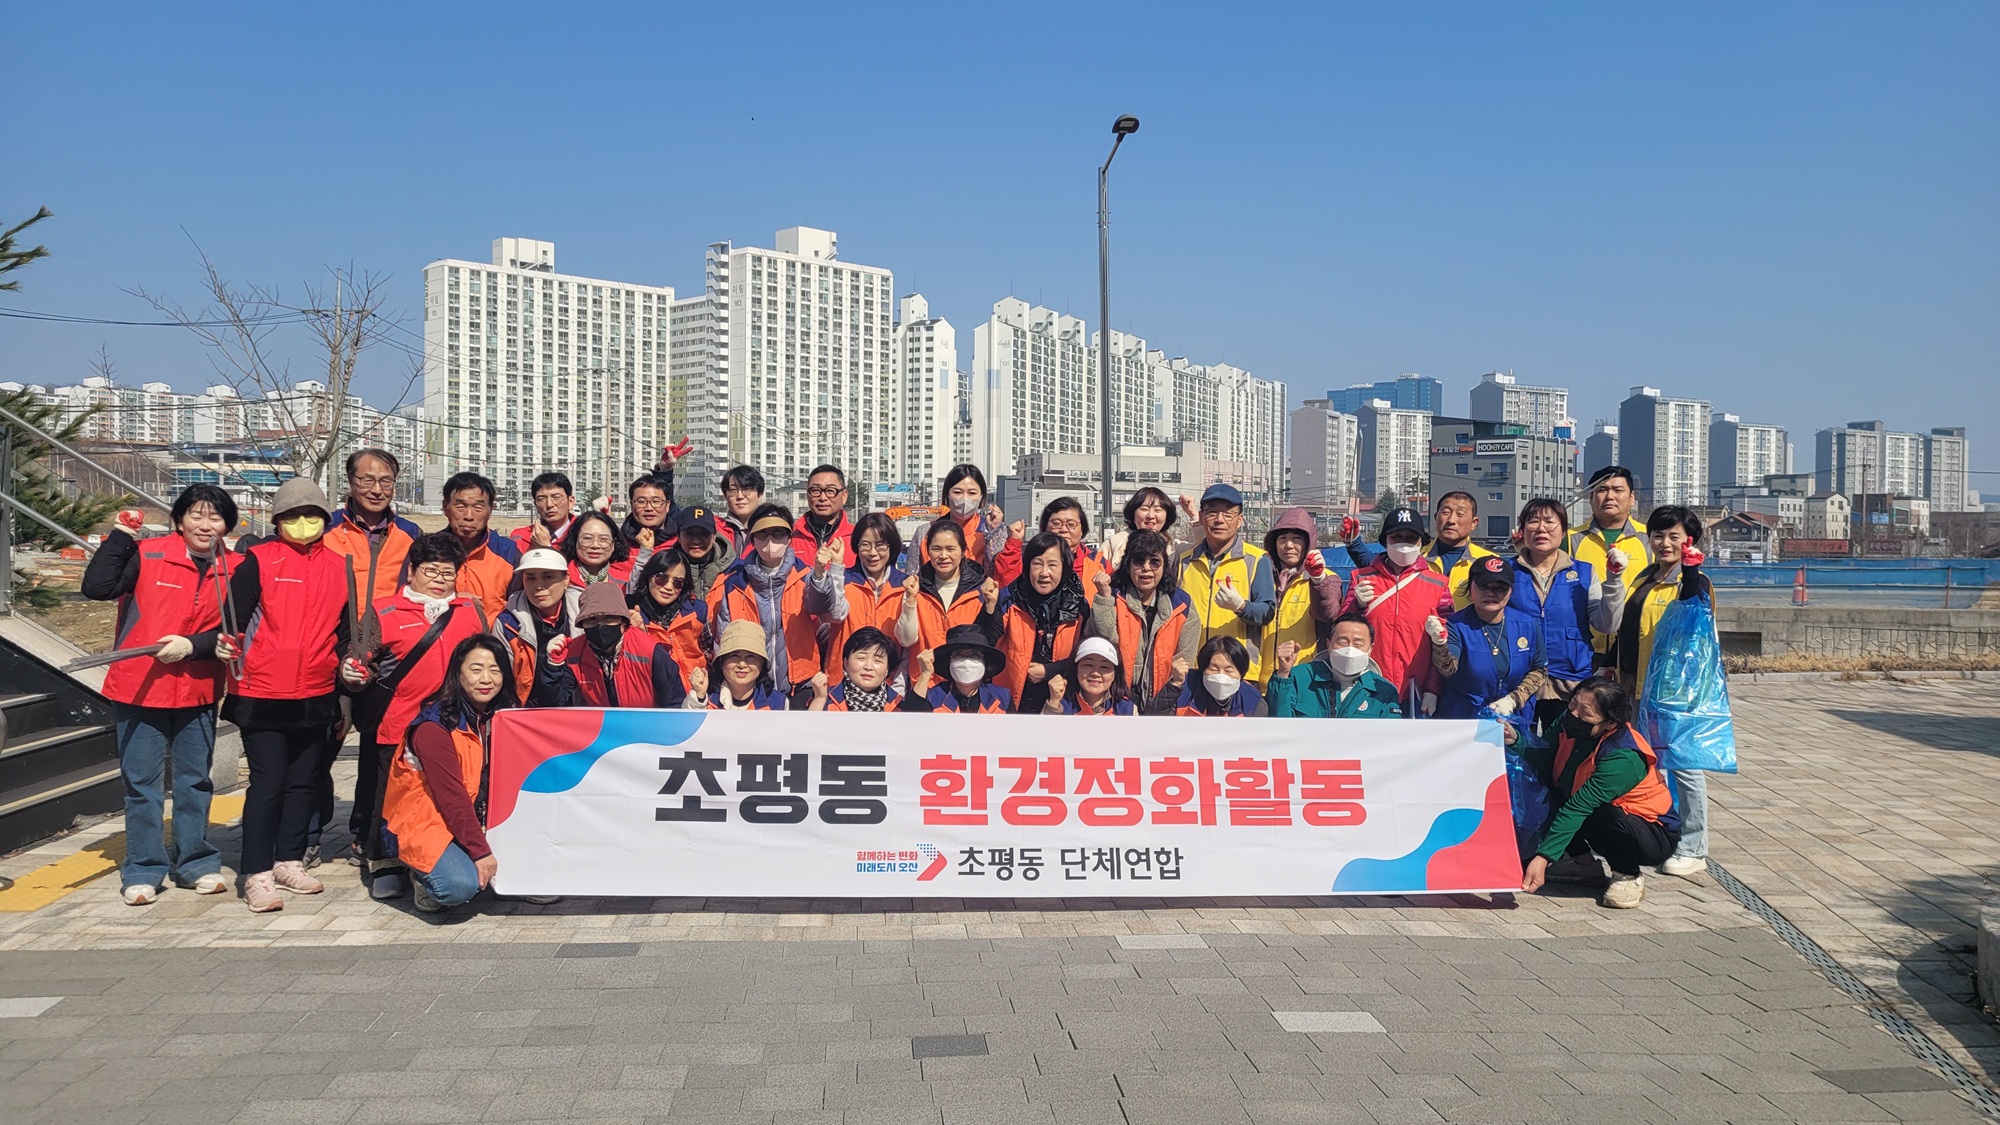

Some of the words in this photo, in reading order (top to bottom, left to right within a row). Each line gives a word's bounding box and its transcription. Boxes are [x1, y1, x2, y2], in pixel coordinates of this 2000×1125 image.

[1501, 443, 1514, 451] CAFE
[694, 509, 704, 519] P
[1397, 510, 1412, 523] NY
[655, 751, 888, 825] 초평동
[920, 753, 1368, 827] 환경정화활동
[856, 851, 896, 861] 함께하는
[898, 851, 919, 861] 변화
[856, 862, 896, 872] 미래도시
[898, 862, 919, 872] 오산
[957, 846, 1045, 881] 초평동
[1060, 847, 1184, 880] 단체연합
